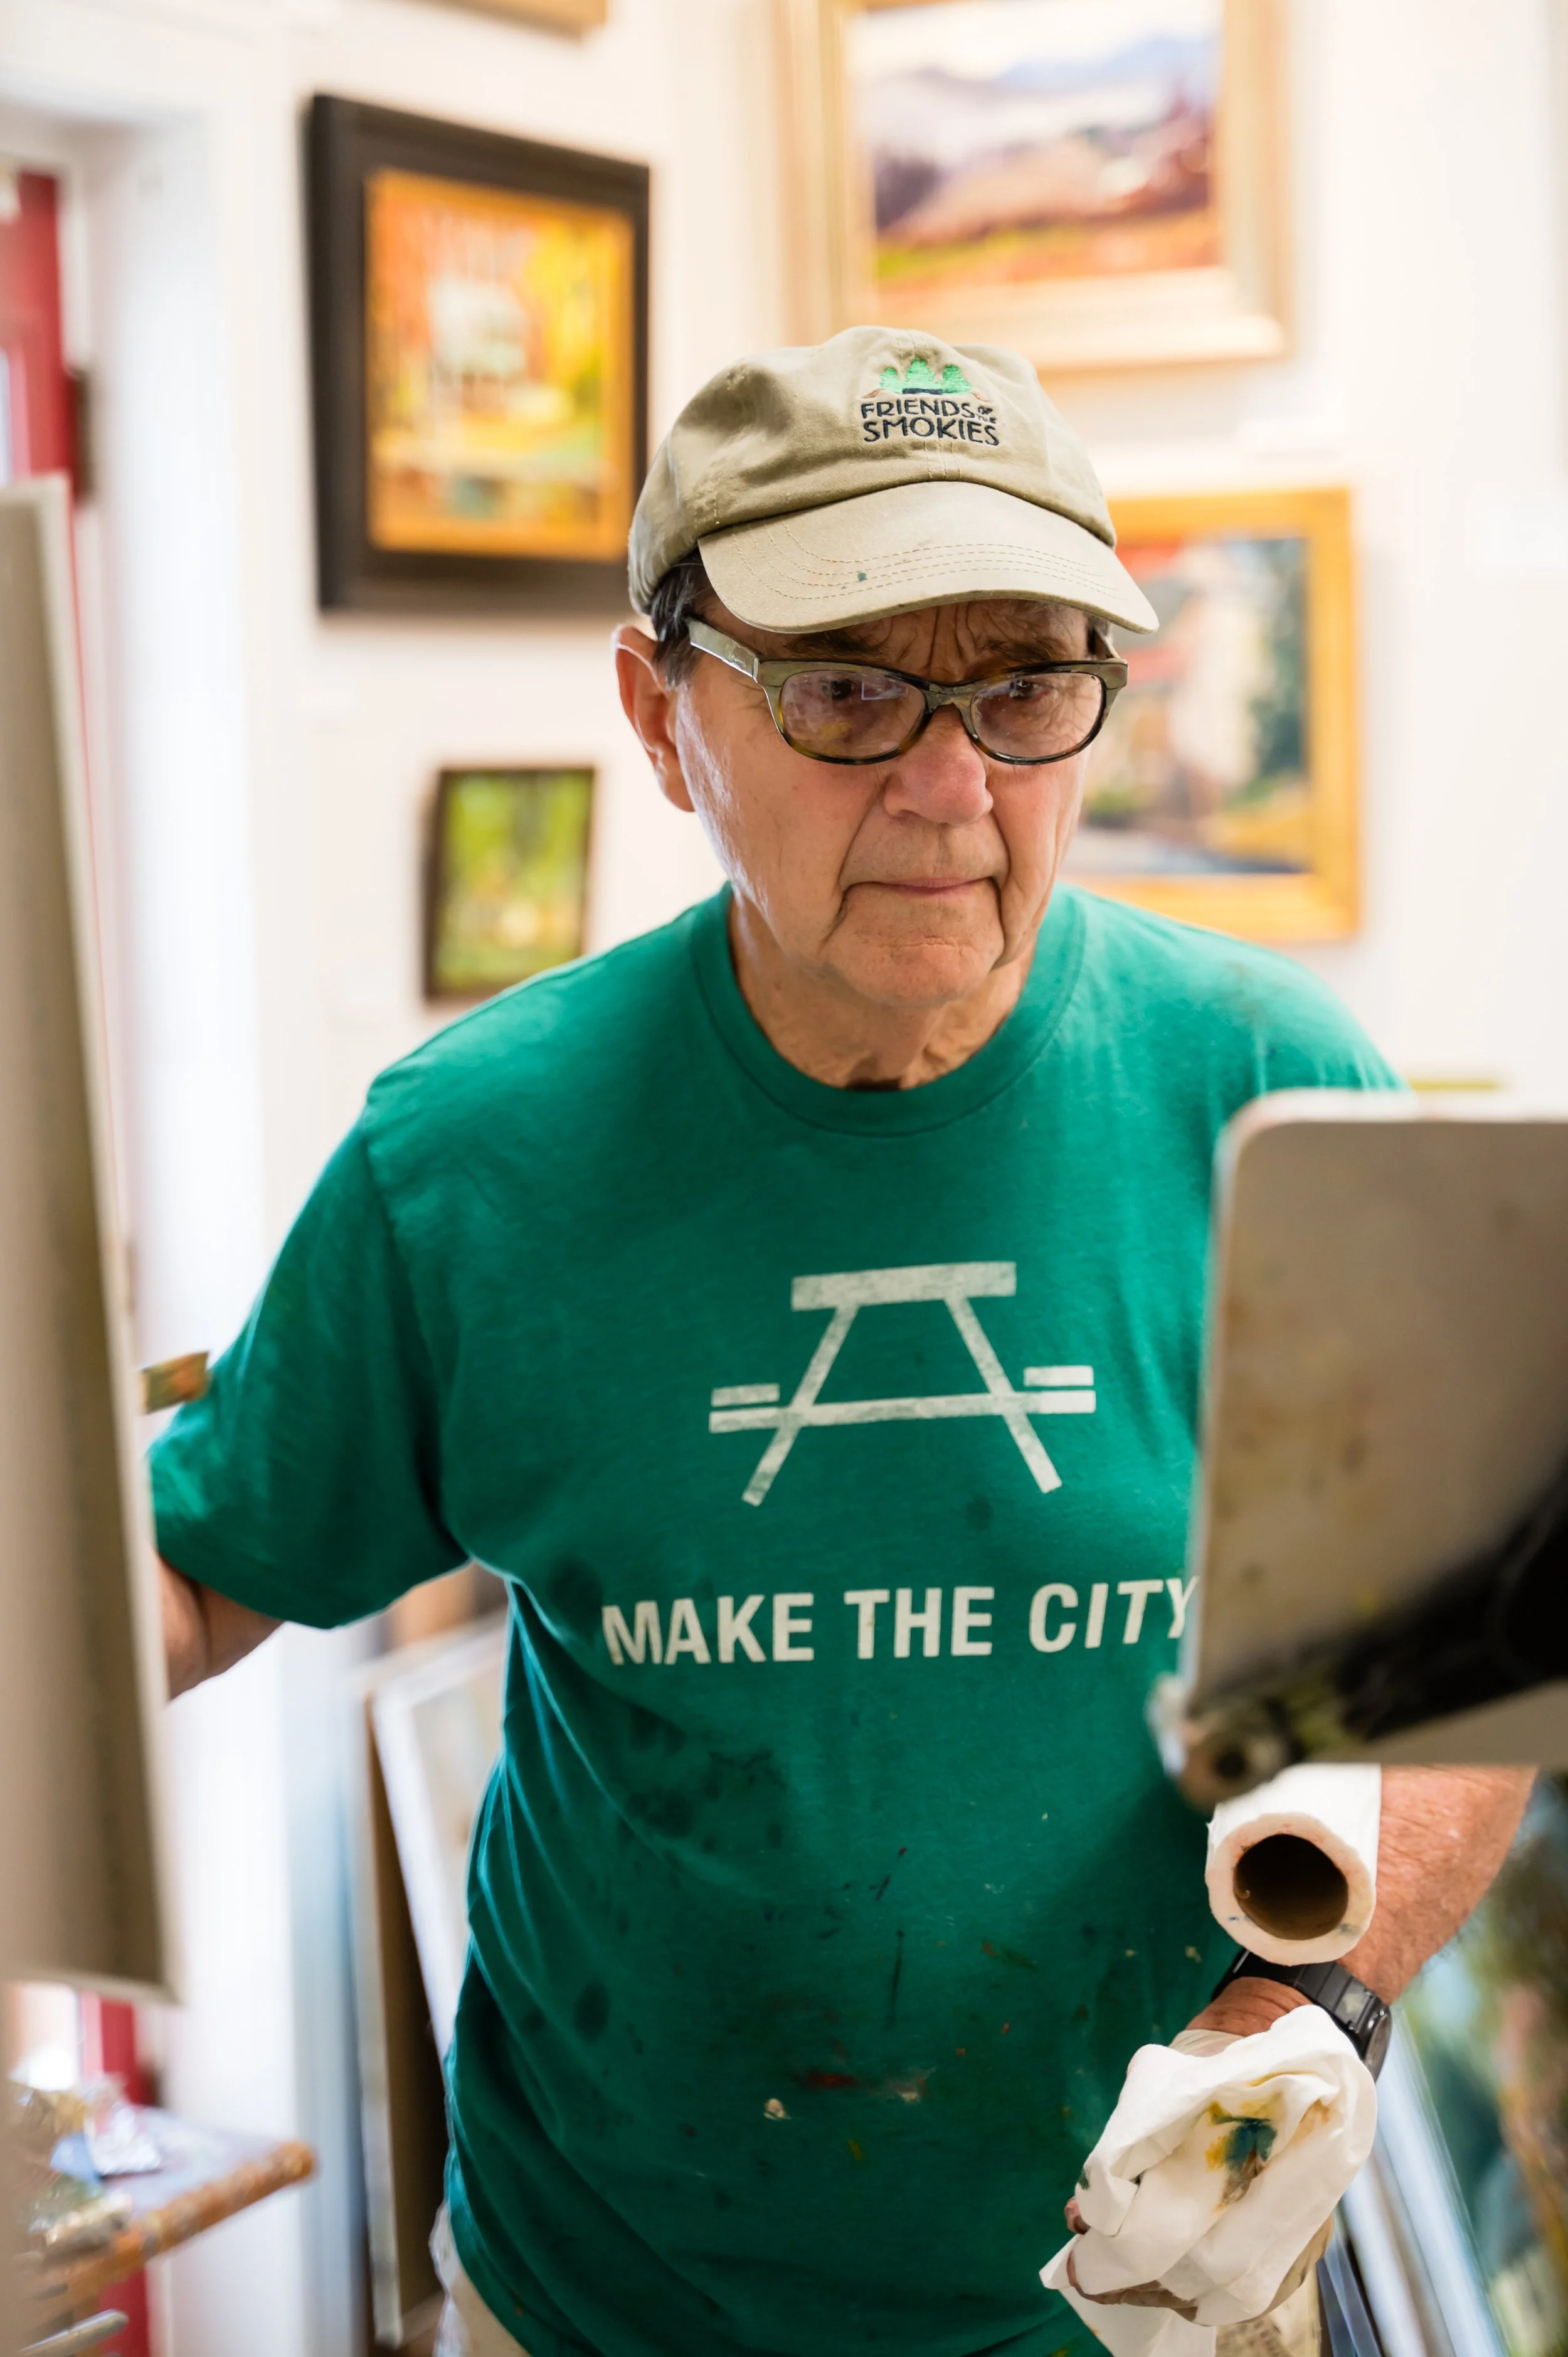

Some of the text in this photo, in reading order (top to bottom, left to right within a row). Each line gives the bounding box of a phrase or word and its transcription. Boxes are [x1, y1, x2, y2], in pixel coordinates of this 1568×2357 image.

[861, 398, 975, 419] FRIENDS
[863, 417, 1000, 446] SMOKIES
[601, 1575, 1200, 1666] MAKE THE CITY
